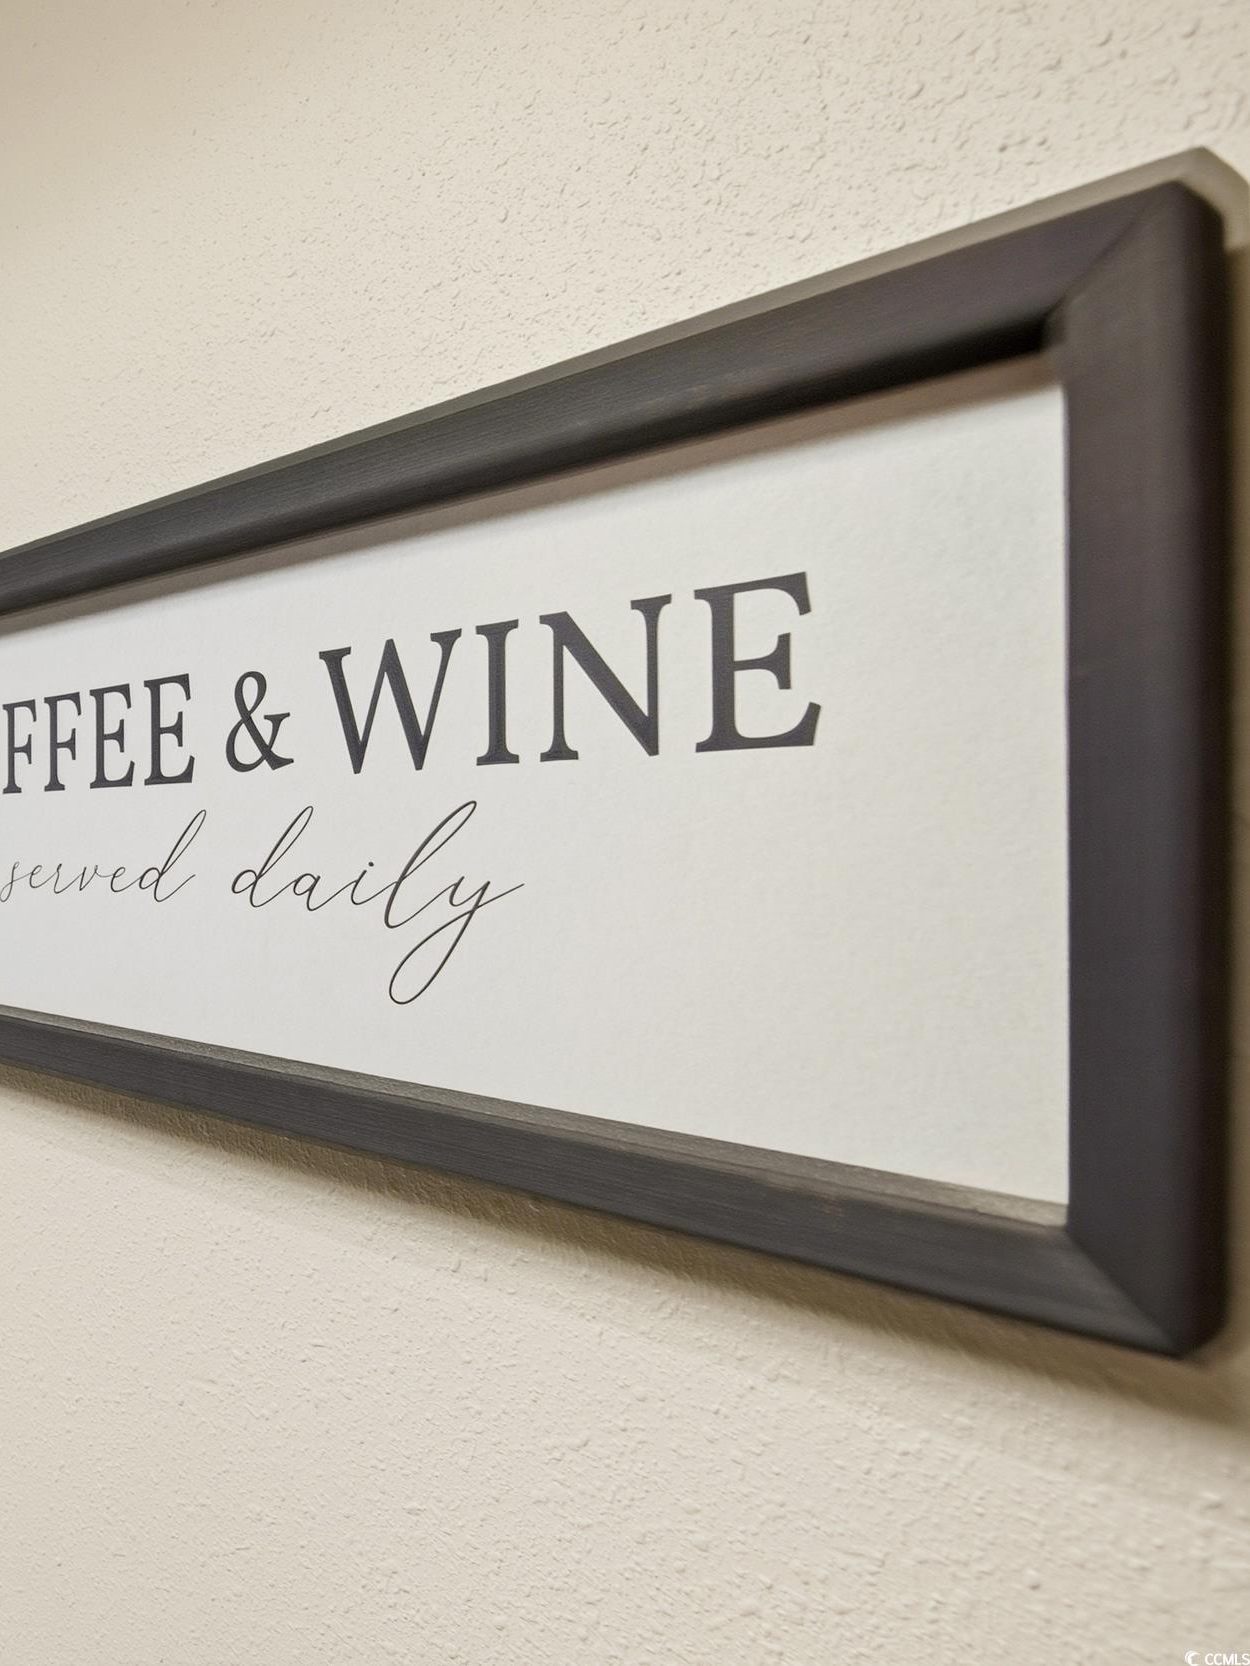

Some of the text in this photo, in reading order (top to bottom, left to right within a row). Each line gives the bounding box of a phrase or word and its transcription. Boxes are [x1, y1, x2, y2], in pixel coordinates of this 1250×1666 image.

[225, 671, 294, 773] &
[319, 571, 822, 774] WINE
[0, 800, 525, 1005] served daily
